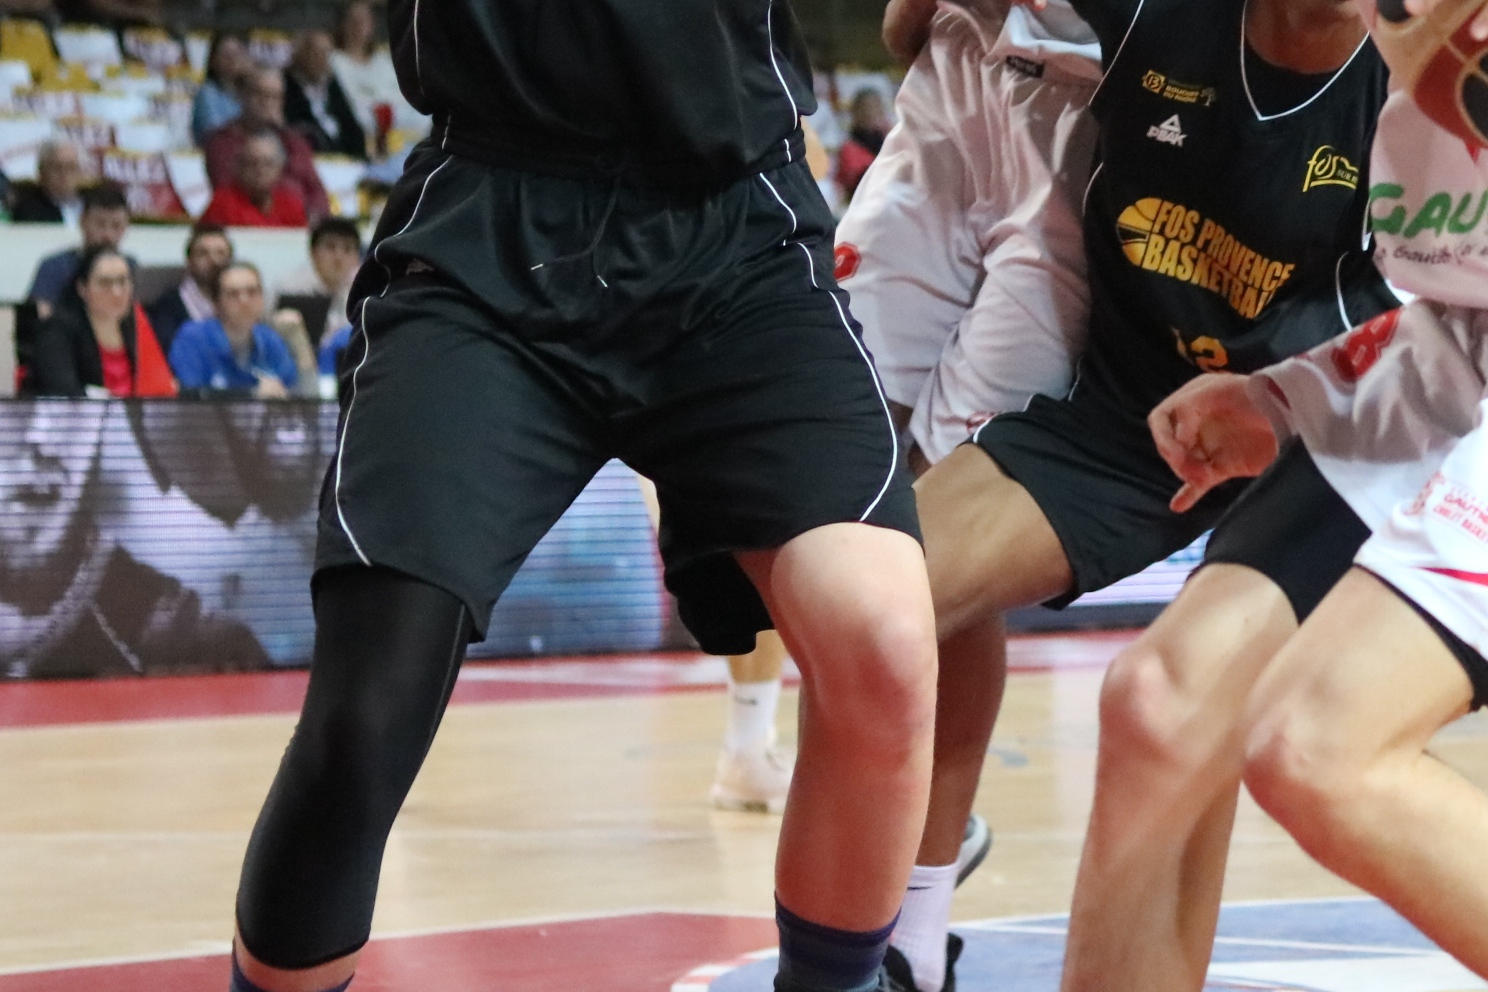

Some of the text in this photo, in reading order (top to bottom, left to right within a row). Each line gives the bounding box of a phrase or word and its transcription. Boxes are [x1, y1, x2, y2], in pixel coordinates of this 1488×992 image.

[1146, 124, 1188, 148] PEAK
[1152, 200, 1296, 293] FOS PROVENCE
